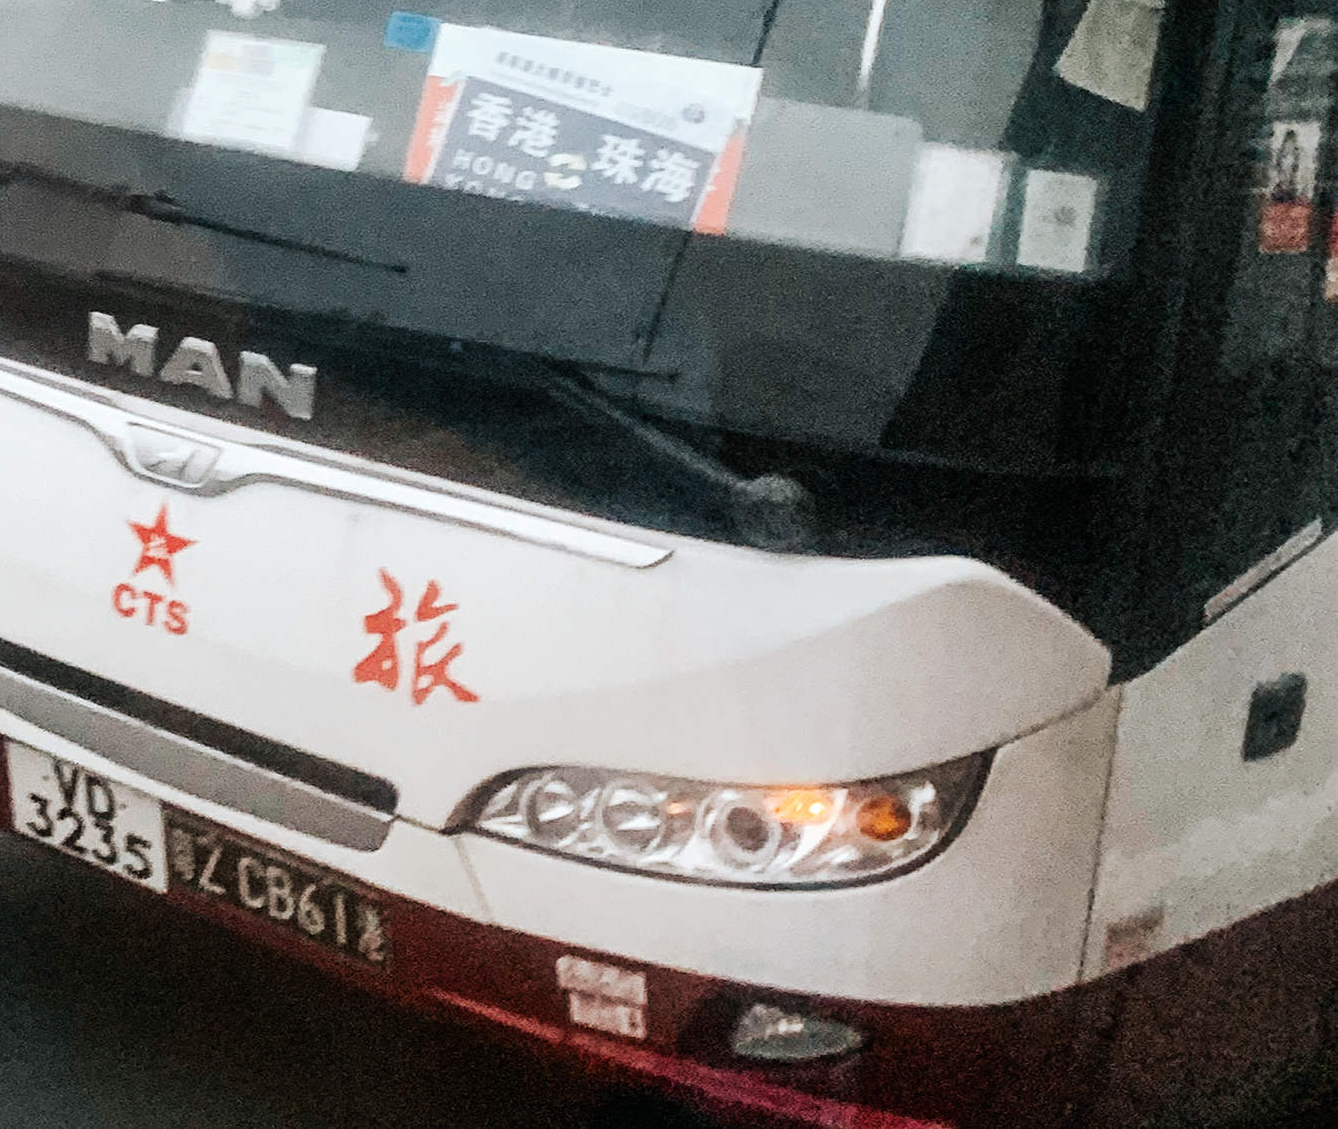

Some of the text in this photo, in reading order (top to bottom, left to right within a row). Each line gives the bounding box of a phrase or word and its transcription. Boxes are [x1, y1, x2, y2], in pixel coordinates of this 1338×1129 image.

[452, 148, 538, 191] HONG
[466, 91, 561, 158] 香港
[591, 134, 702, 203] 珠海
[87, 310, 318, 420] MAN
[112, 582, 189, 636] CTS
[352, 568, 480, 705] 旅
[26, 792, 153, 880] 3235
